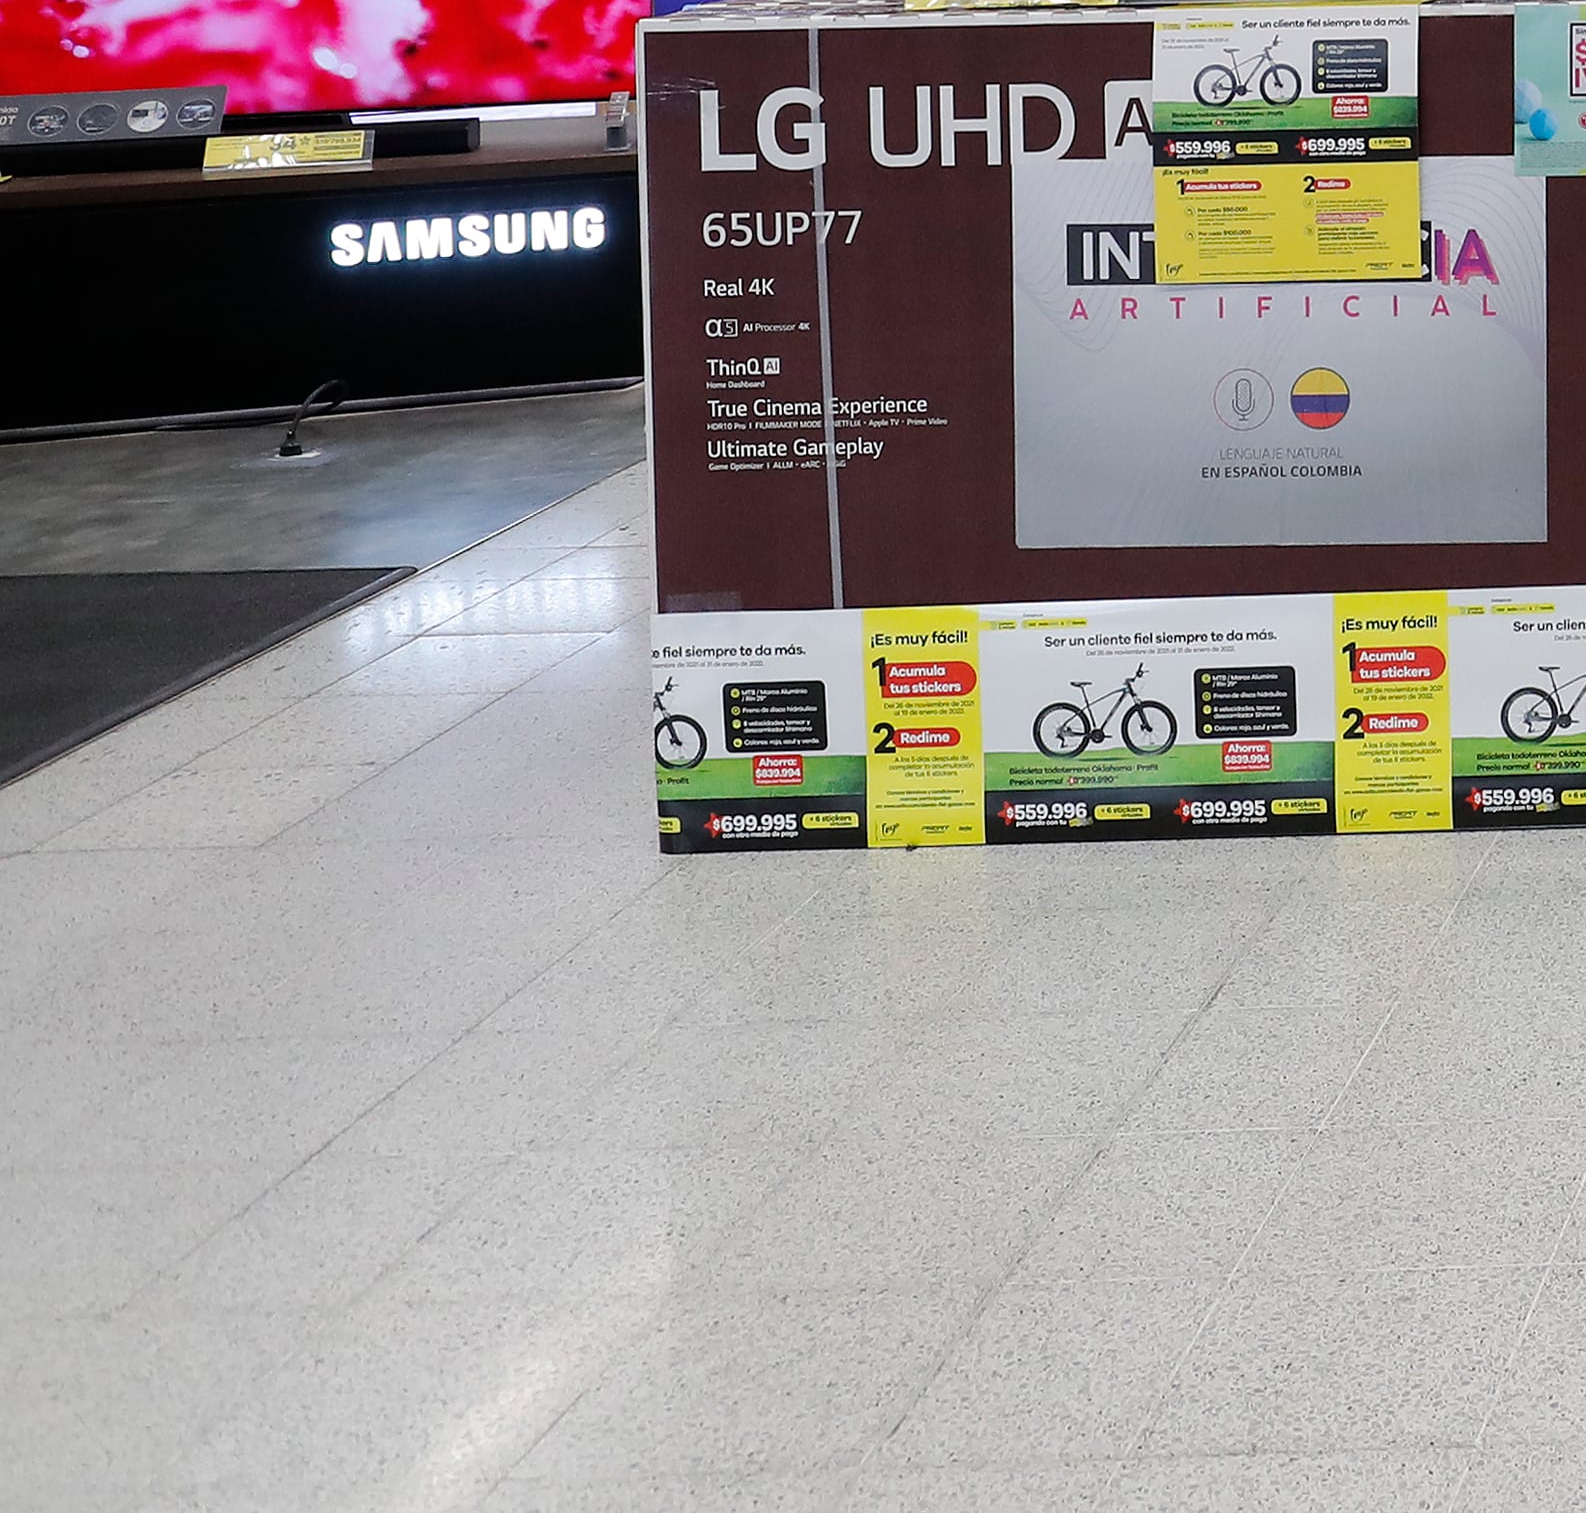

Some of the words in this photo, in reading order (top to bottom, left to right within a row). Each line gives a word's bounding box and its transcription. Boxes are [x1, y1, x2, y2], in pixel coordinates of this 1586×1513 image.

[1241, 19, 1258, 30] Ser
[700, 87, 827, 172] LG
[868, 82, 1077, 168] UHD
[328, 206, 608, 268] SAMSUNG
[701, 209, 863, 248] 65UP77
[703, 278, 743, 297] Real
[748, 278, 776, 297] 4K
[1069, 294, 1498, 321] ARTIFICIAL
[755, 322, 796, 333] Processor
[706, 357, 762, 377] ThinQ
[728, 379, 766, 389] Dashboard
[707, 399, 748, 417] True
[753, 397, 823, 417] Cinema
[829, 396, 928, 418] Experience
[706, 439, 788, 459] Ultimate
[1219, 447, 1284, 461] LENGUAJE
[1286, 446, 1344, 460] NATURAL
[1201, 466, 1221, 479] EN
[1224, 462, 1287, 479] ESPAÑOL
[1290, 465, 1363, 479] COLOMBIA
[1365, 619, 1399, 634] muy
[1402, 615, 1438, 629] fácil!
[1512, 620, 1538, 633] Ser
[1540, 622, 1553, 632] un
[895, 634, 928, 648] muy
[932, 630, 968, 644] fácil!
[1044, 636, 1066, 648] Ser
[1068, 637, 1085, 648] un
[1087, 634, 1132, 647] cliente
[1133, 633, 1154, 645] fiel
[1154, 632, 1208, 648] siempre
[1210, 631, 1223, 643] te
[1224, 630, 1244, 643] da
[662, 645, 683, 658] fiel
[684, 644, 738, 660] siempre
[739, 644, 753, 657] te
[754, 644, 773, 656] da
[1342, 642, 1357, 672] 1
[1359, 649, 1416, 662] Acumula
[871, 656, 887, 687] 1
[889, 665, 946, 678] Acumula
[1359, 667, 1381, 679] tus
[1381, 666, 1431, 679] stickers
[890, 681, 911, 694] tus
[912, 680, 962, 694] stickers
[1342, 707, 1365, 739] 2
[1368, 716, 1419, 730] Redime
[872, 722, 897, 754] 2
[899, 731, 951, 744] Redime
[1473, 787, 1555, 806] $559.996
[1005, 802, 1088, 821] $559.996
[1181, 799, 1267, 819] $699.995
[712, 813, 798, 833] $699.995
